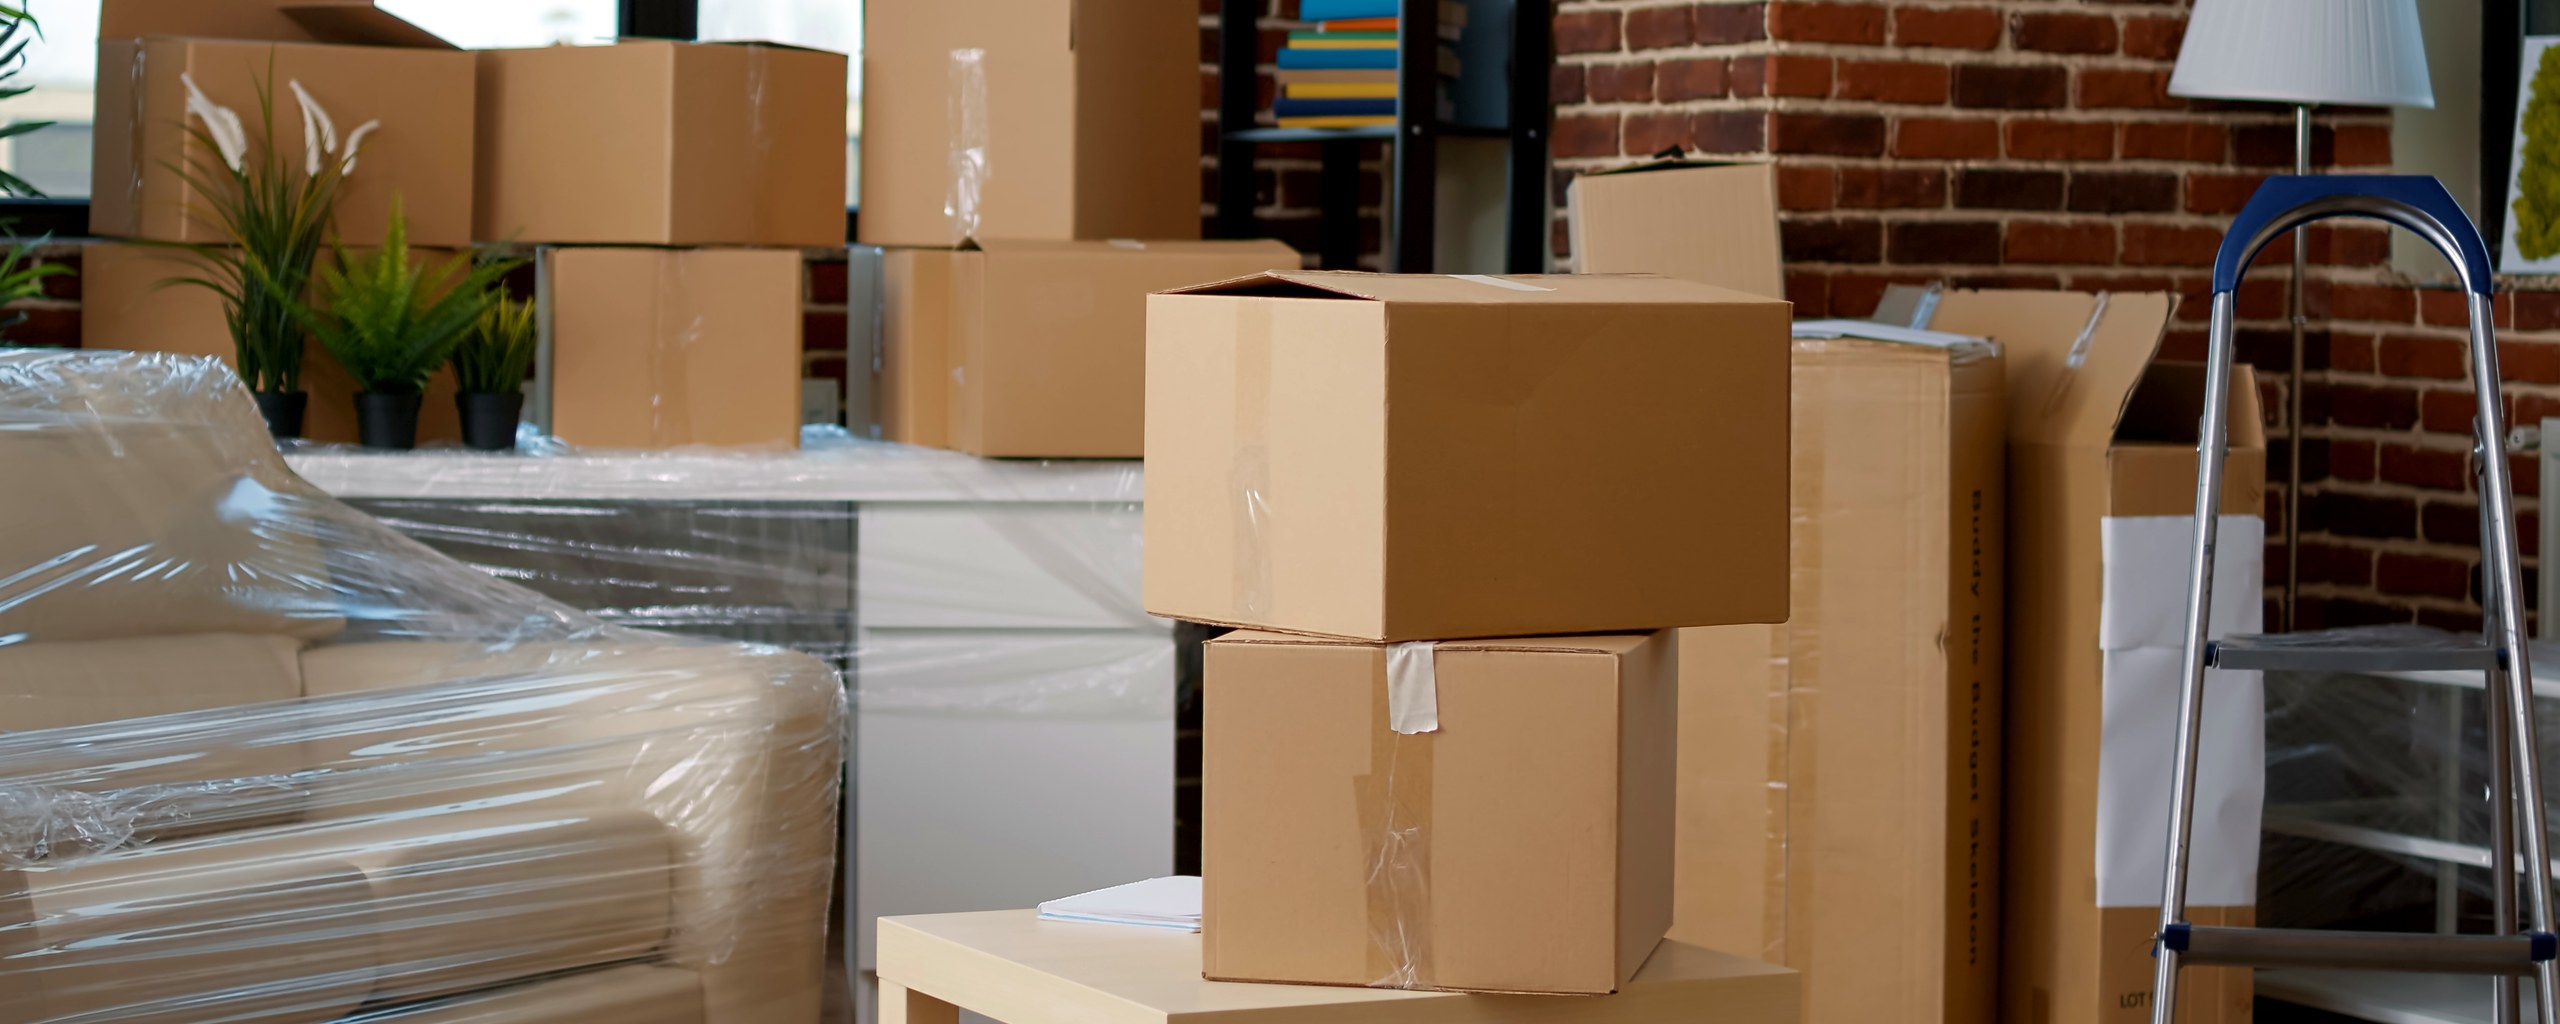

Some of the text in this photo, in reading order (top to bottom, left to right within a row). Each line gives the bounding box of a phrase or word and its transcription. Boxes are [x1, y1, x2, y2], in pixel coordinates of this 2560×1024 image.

[1967, 488, 1982, 967] Buddy the Budget Skeleton
[2119, 991, 2146, 1009] LOT
